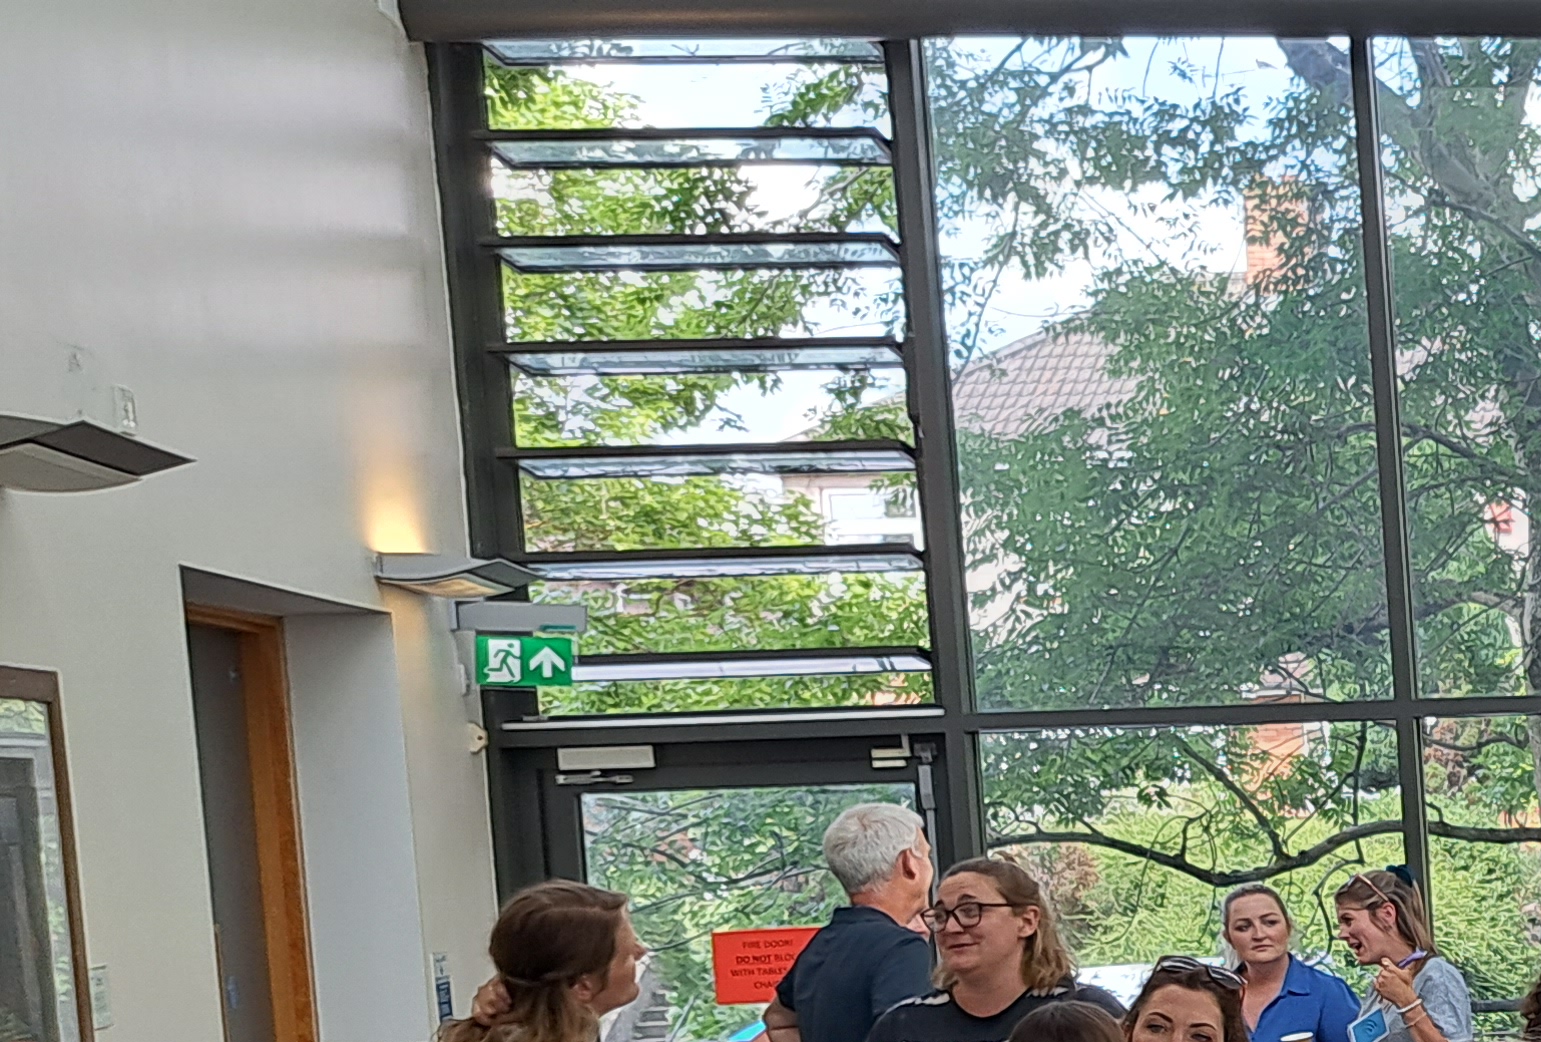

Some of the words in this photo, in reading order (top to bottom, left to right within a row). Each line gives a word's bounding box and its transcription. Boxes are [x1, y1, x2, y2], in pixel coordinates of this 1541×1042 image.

[742, 940, 761, 949] FIRE
[736, 956, 750, 965] DO
[752, 954, 772, 965] NOT
[730, 969, 755, 977] WITH
